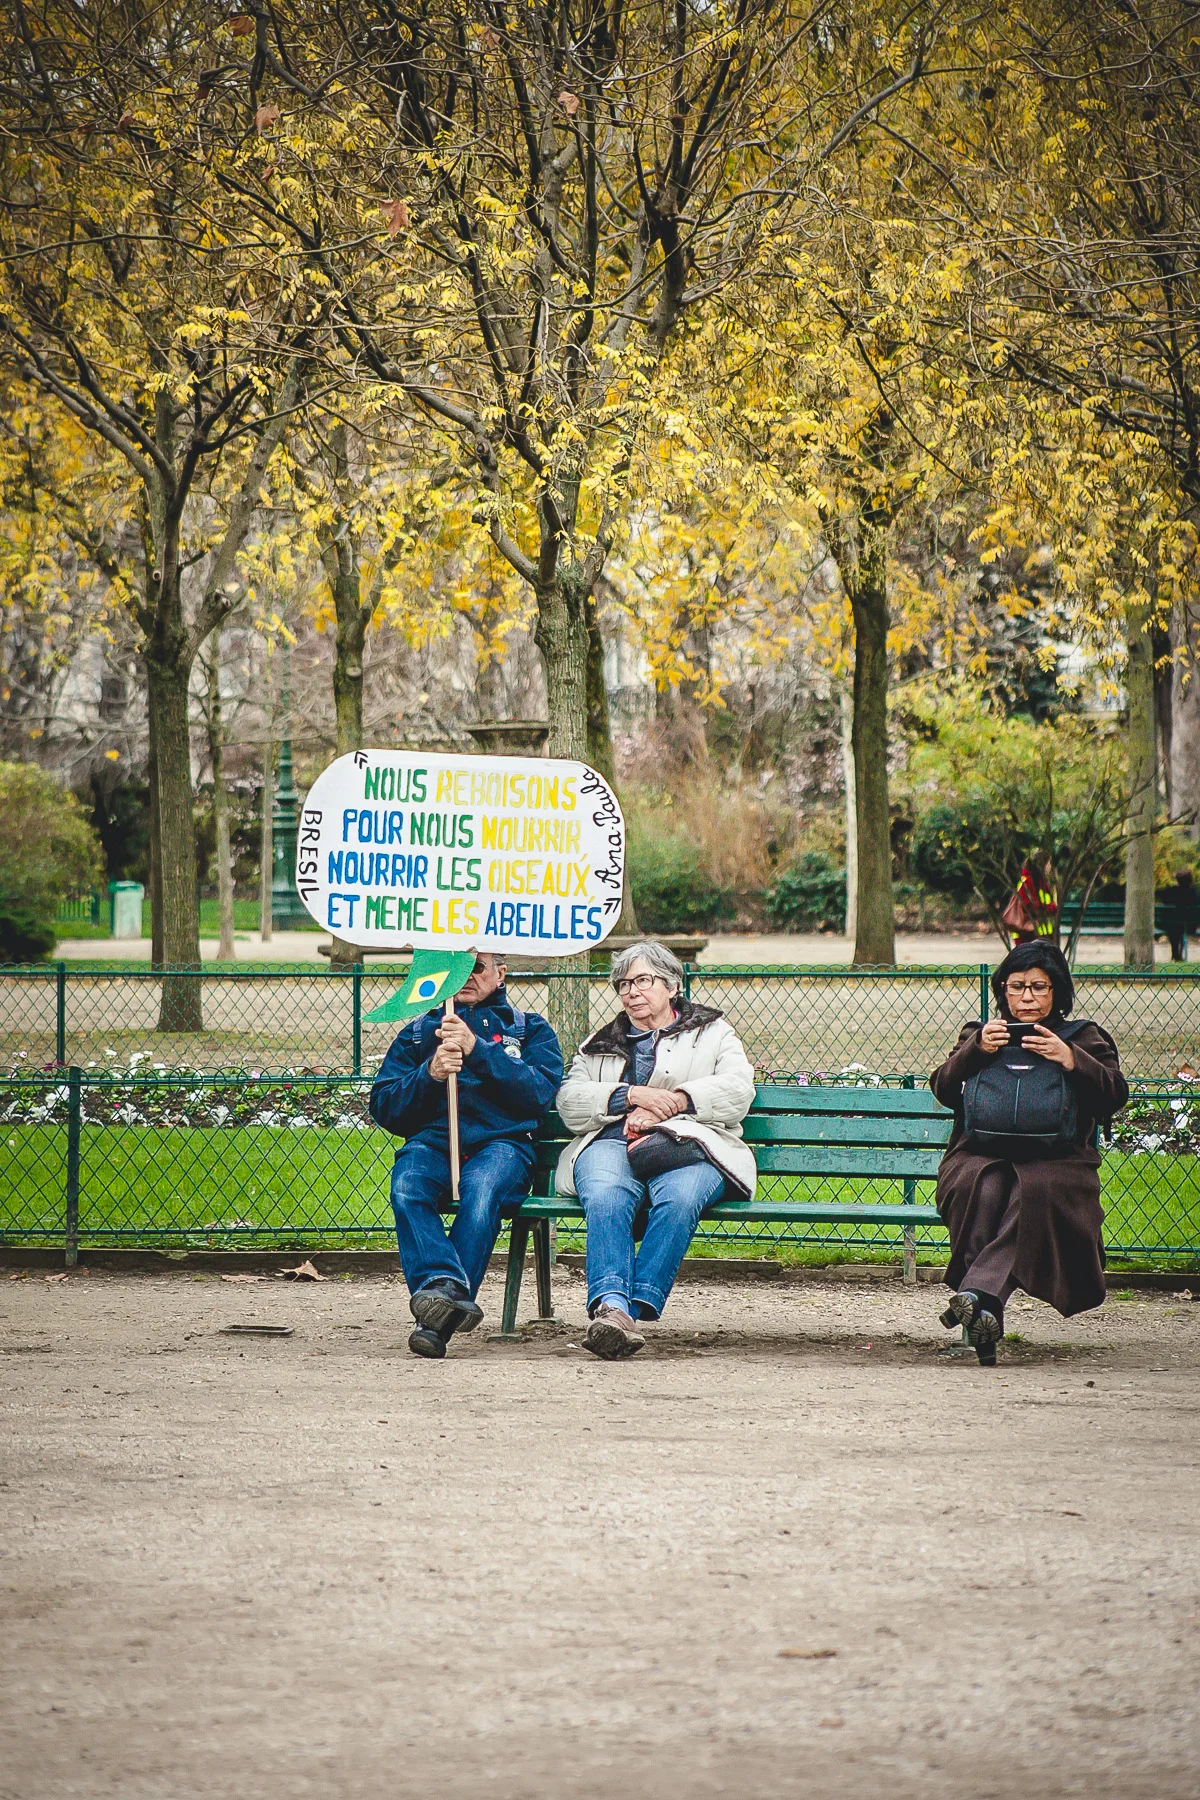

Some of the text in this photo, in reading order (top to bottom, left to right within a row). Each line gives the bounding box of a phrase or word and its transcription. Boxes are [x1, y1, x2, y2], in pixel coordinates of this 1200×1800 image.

[364, 767, 428, 803] NOUS
[435, 769, 577, 811] REBOISONS
[342, 808, 404, 845] POUR
[410, 812, 474, 848] NOUS
[297, 809, 323, 901] BRESIL
[328, 850, 429, 889] NOURRIR
[436, 856, 482, 892] LES
[327, 892, 361, 928] ET
[365, 895, 429, 932] MEME
[431, 898, 480, 935] LES
[484, 901, 602, 941] ABEILLES
